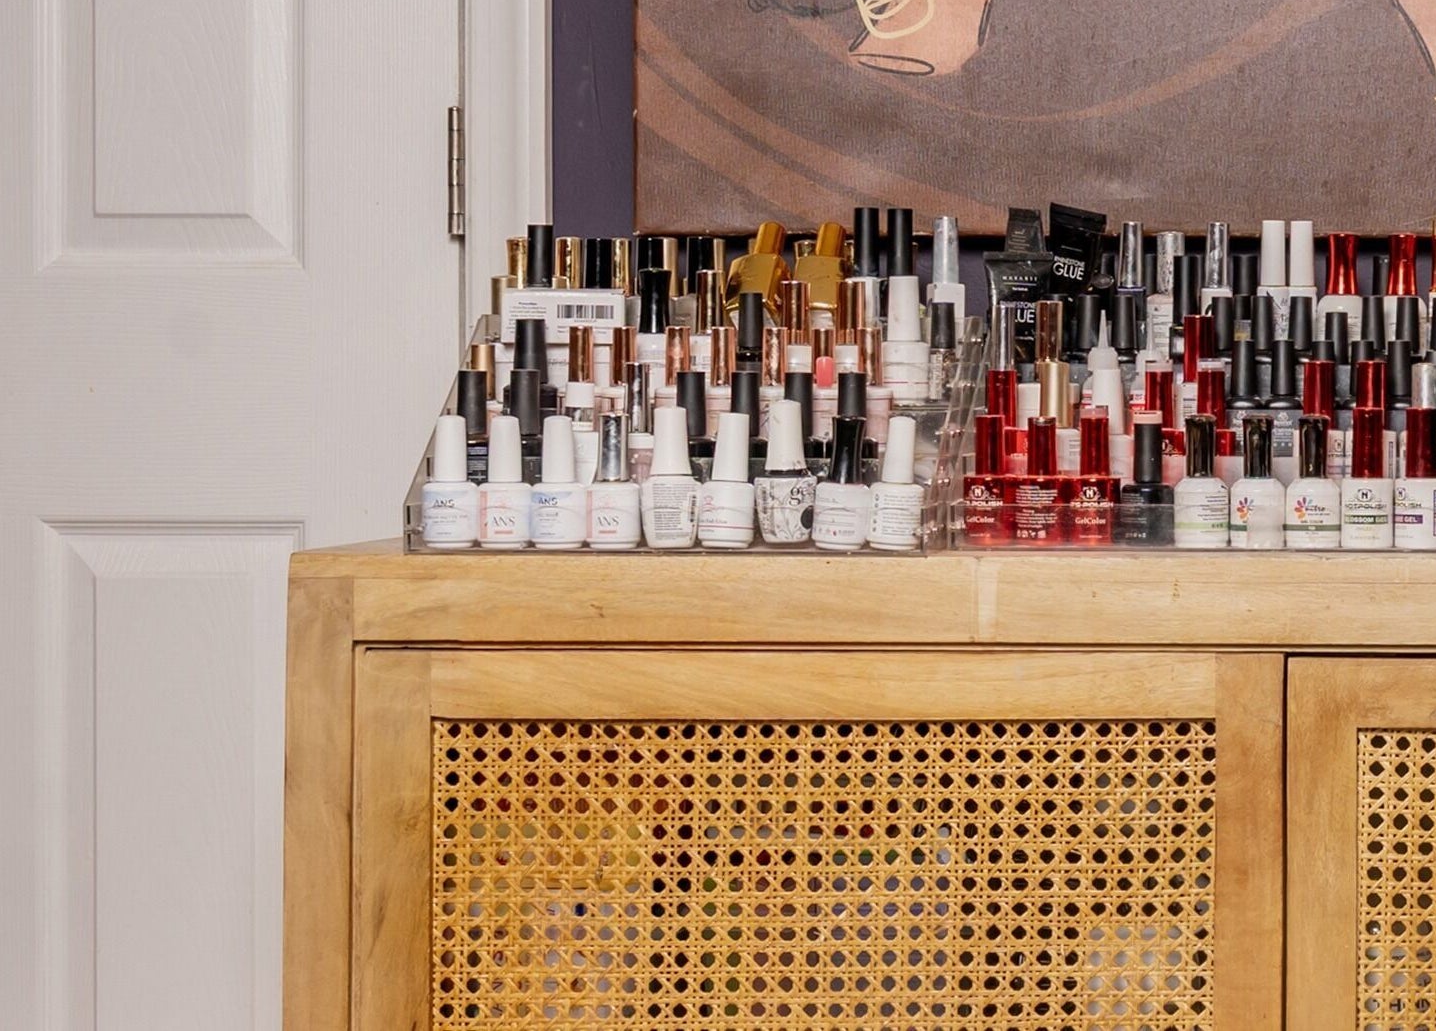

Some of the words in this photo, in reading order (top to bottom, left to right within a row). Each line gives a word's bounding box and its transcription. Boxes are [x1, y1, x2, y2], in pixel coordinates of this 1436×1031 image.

[1052, 262, 1085, 281] GLUE
[432, 498, 455, 508] ANS
[1074, 517, 1107, 526] GelColor
